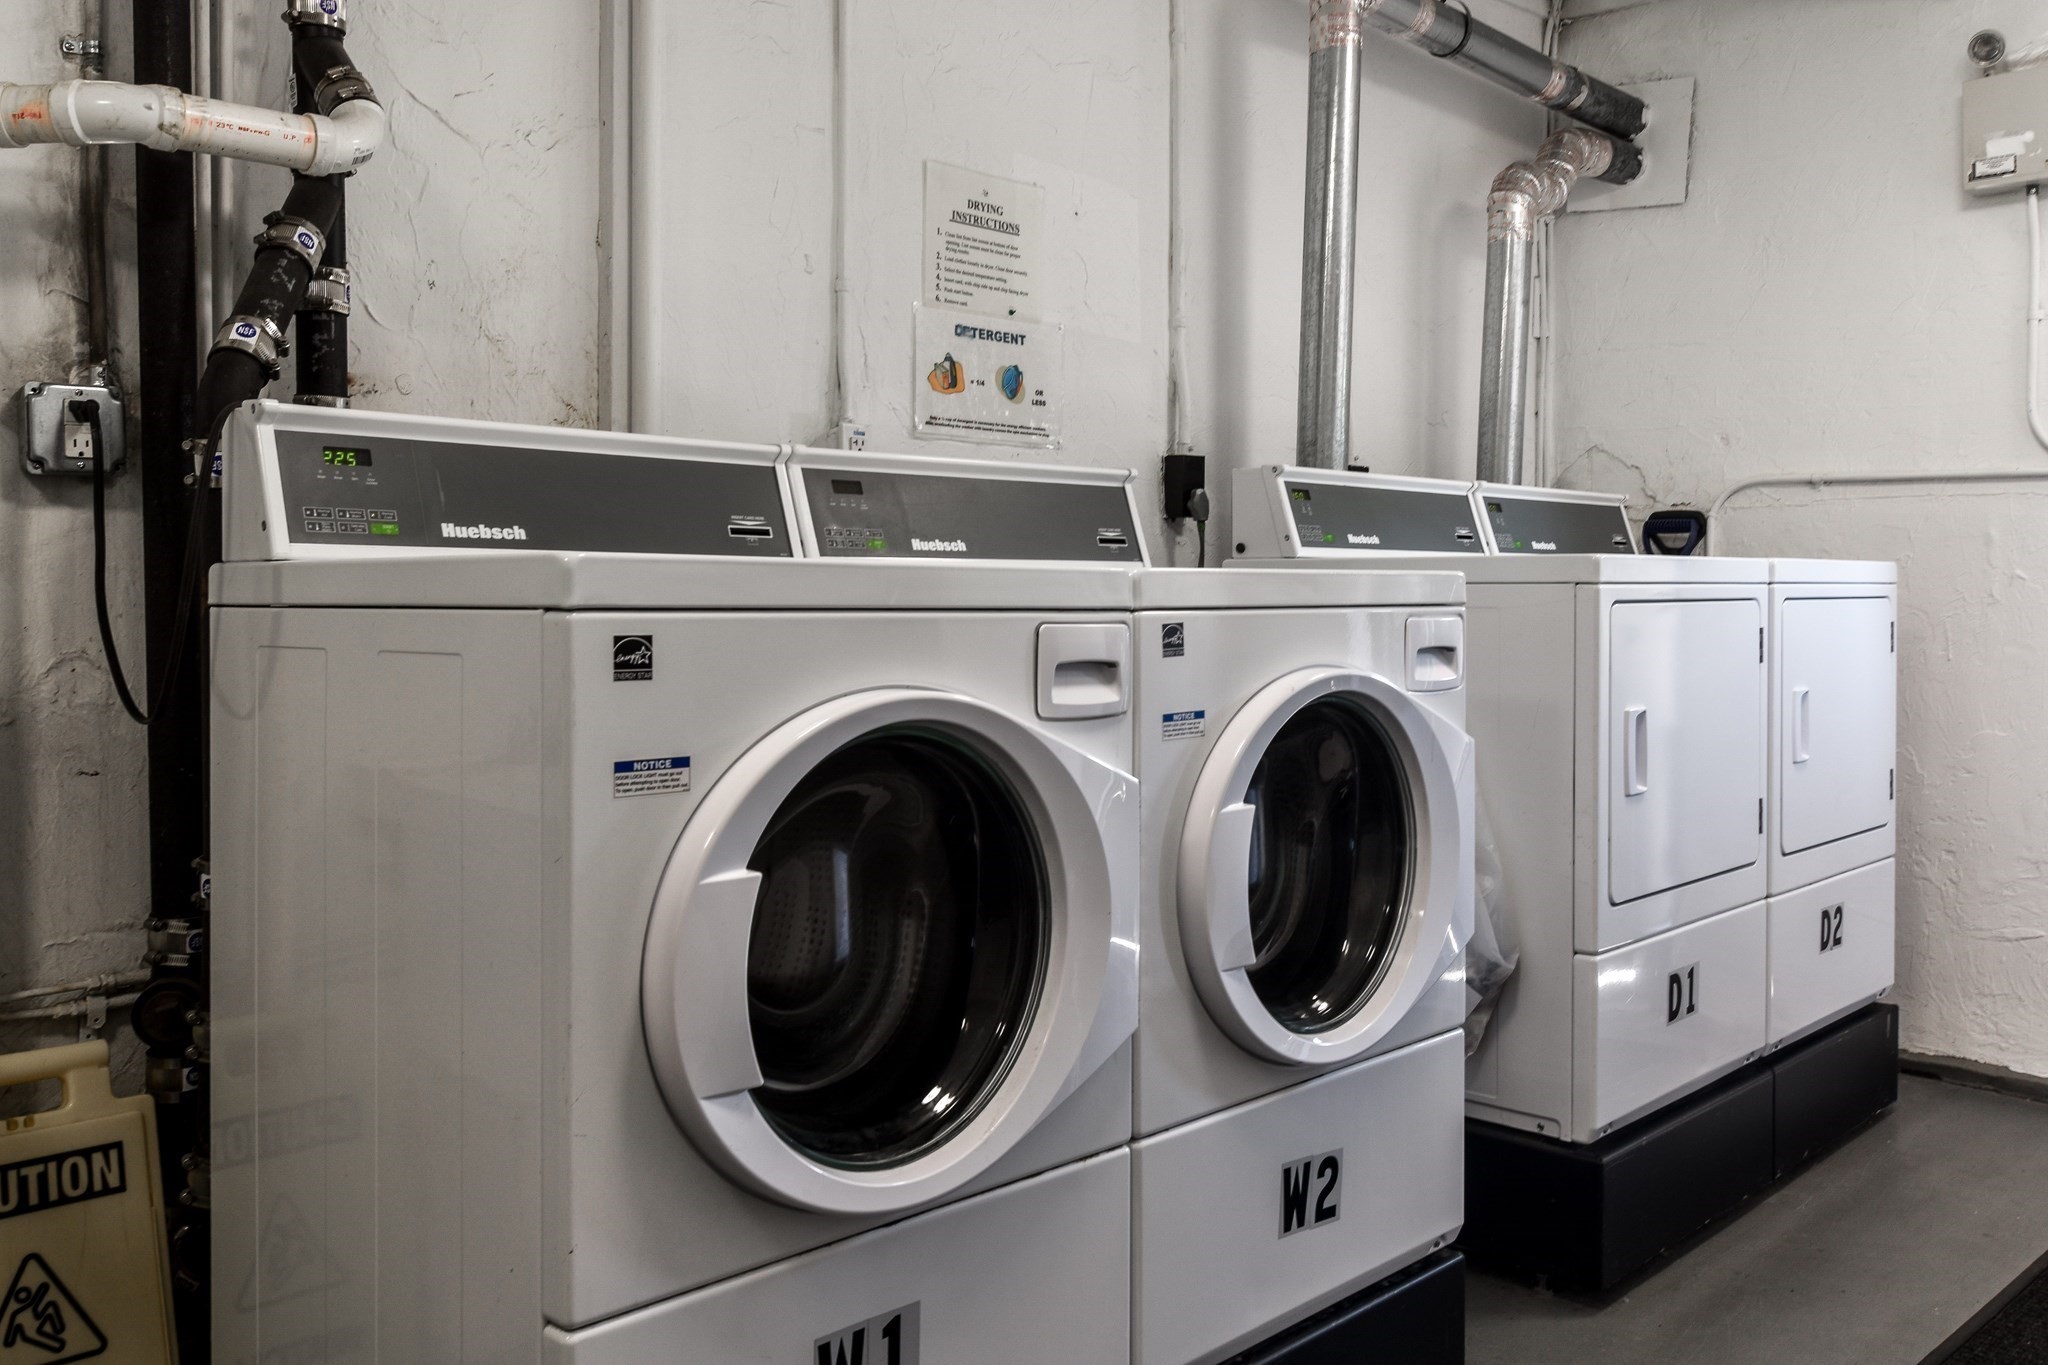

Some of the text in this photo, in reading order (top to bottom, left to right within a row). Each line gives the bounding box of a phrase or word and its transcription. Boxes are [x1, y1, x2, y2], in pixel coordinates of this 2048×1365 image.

[968, 198, 1004, 216] DRYING
[952, 210, 1020, 234] INSTRUCTIONS
[238, 324, 256, 336] NSF
[441, 522, 526, 540] Huebsch
[911, 538, 967, 551] Huebsch
[1173, 712, 1194, 721] NOTICE
[633, 759, 672, 770] NOTICE
[1820, 906, 1843, 951] D2
[1668, 966, 1695, 1023] D1
[1283, 1155, 1339, 1234] W2
